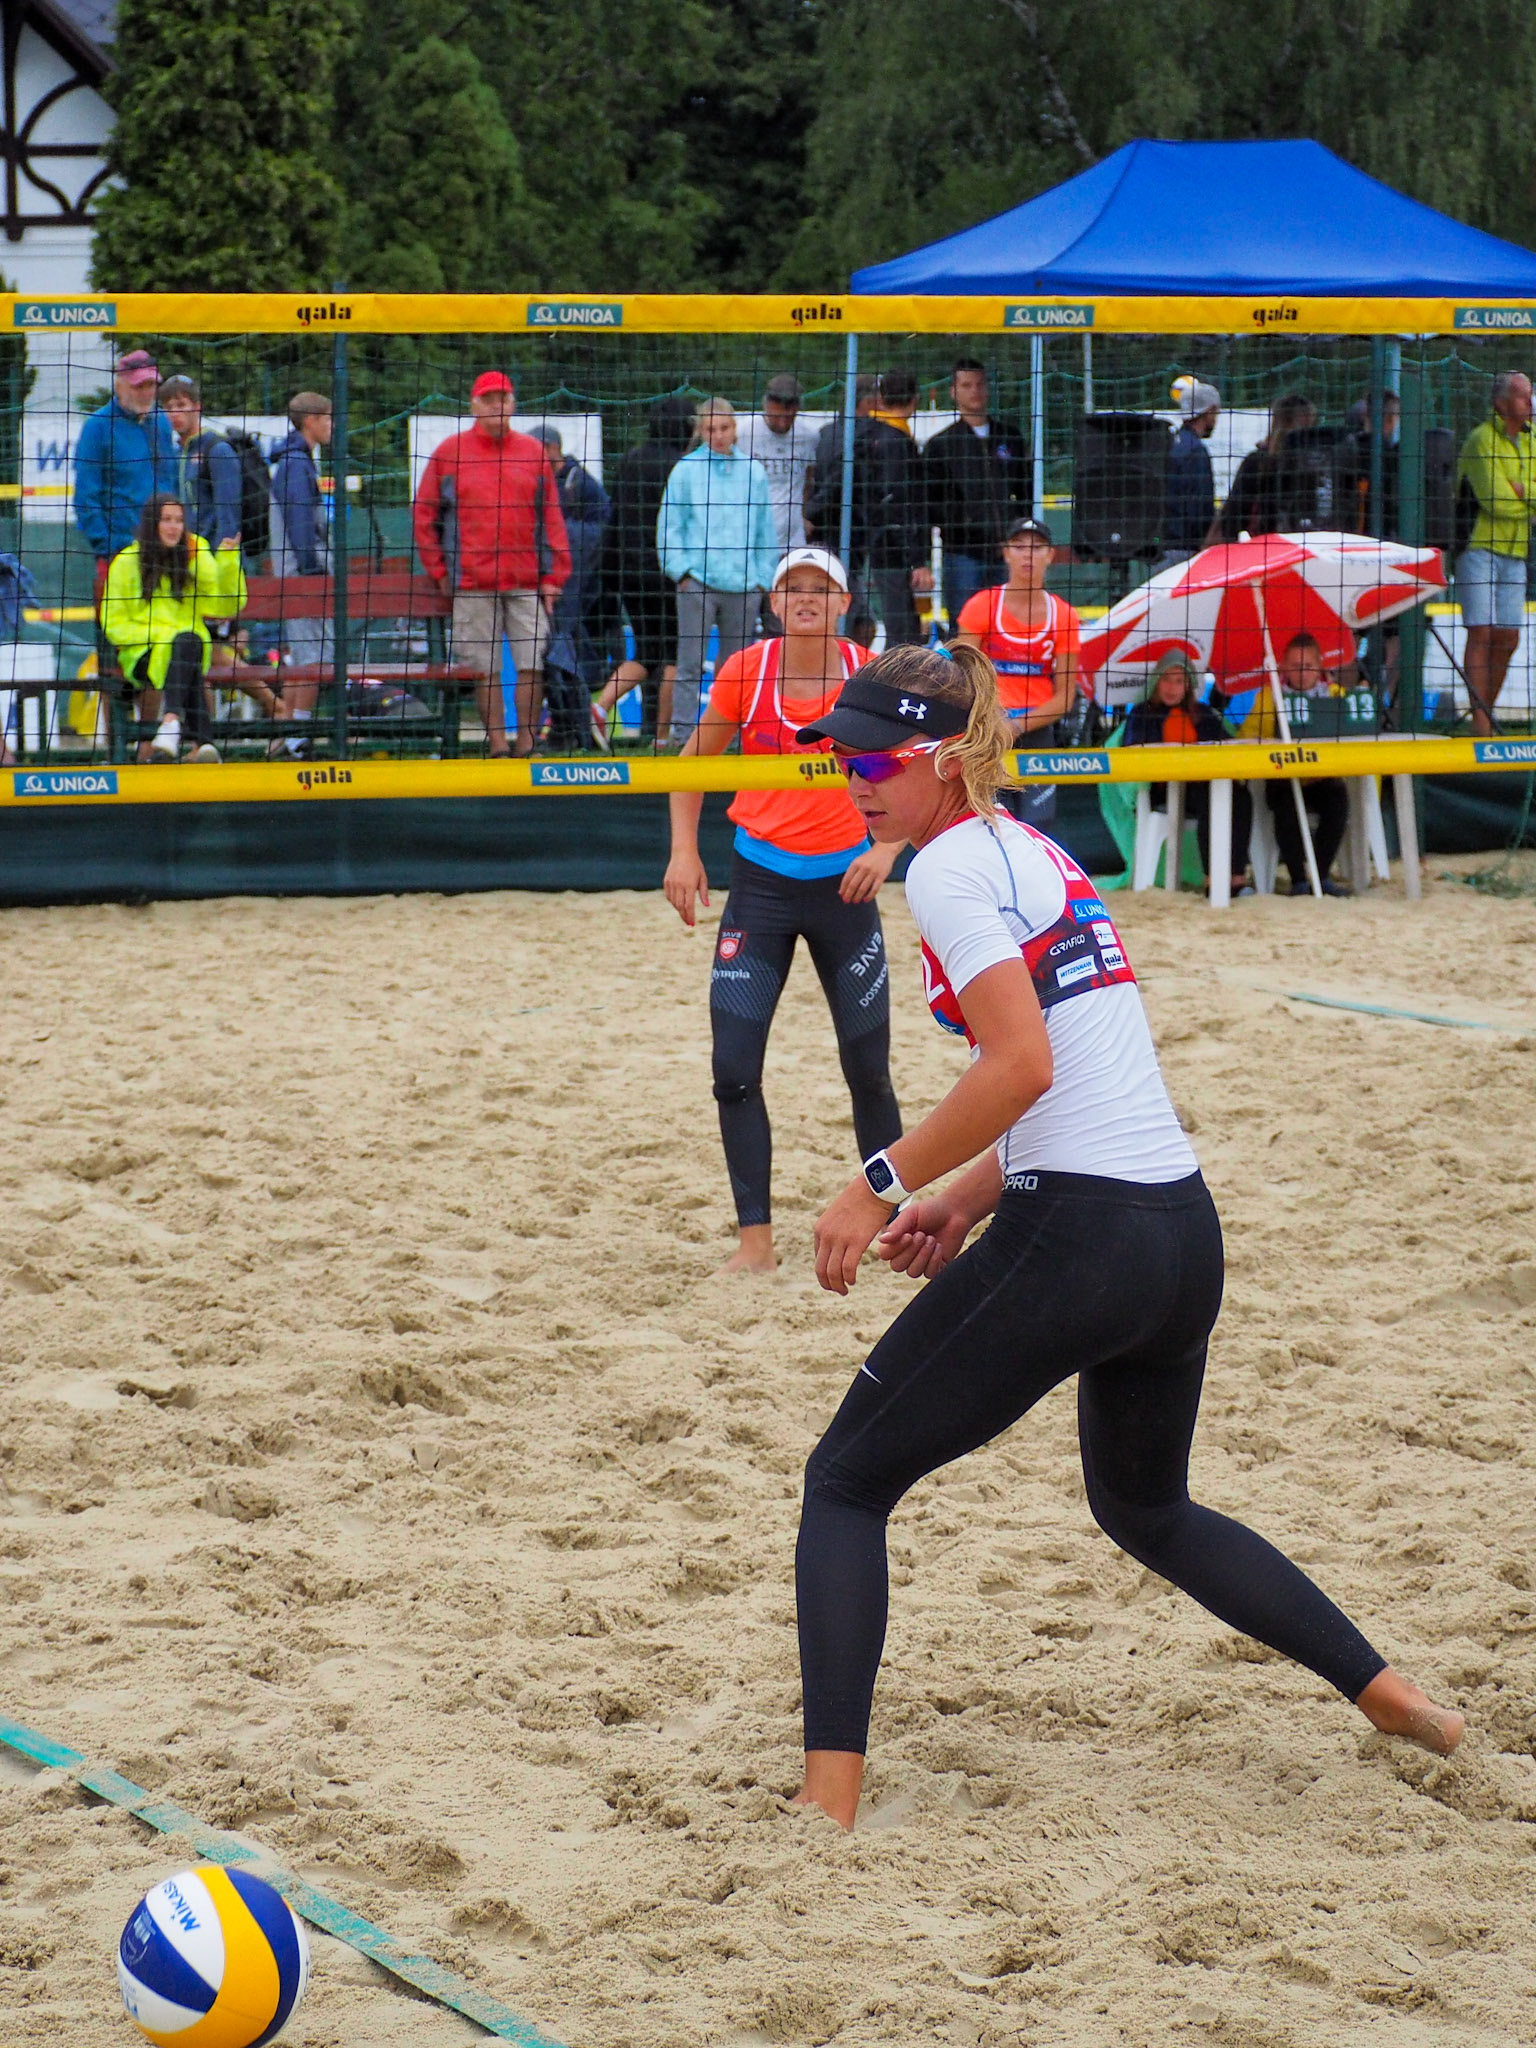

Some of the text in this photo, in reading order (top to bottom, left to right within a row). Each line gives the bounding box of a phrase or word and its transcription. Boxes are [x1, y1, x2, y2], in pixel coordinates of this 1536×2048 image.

[51, 308, 109, 323] UNIQA
[297, 302, 351, 326] gala
[560, 308, 614, 323] UNIQA
[791, 303, 842, 326] gala
[1037, 310, 1086, 325] UNIQA
[1253, 304, 1298, 327] gala
[1484, 312, 1532, 326] UNIQA
[1041, 640, 1054, 660] 2
[1345, 693, 1376, 722] 13
[1050, 757, 1103, 772] UNIQA
[1269, 747, 1318, 769] gala
[297, 766, 352, 790] gala
[565, 767, 622, 782] UNIQA
[51, 776, 109, 792] UNIQA
[1049, 934, 1085, 956] GRAFICO
[1060, 960, 1092, 978] WITZENMANN
[1104, 954, 1122, 967] gala
[712, 967, 751, 981] lympia
[1005, 1175, 1038, 1190] PRO
[162, 1879, 201, 1932] MIKAS
